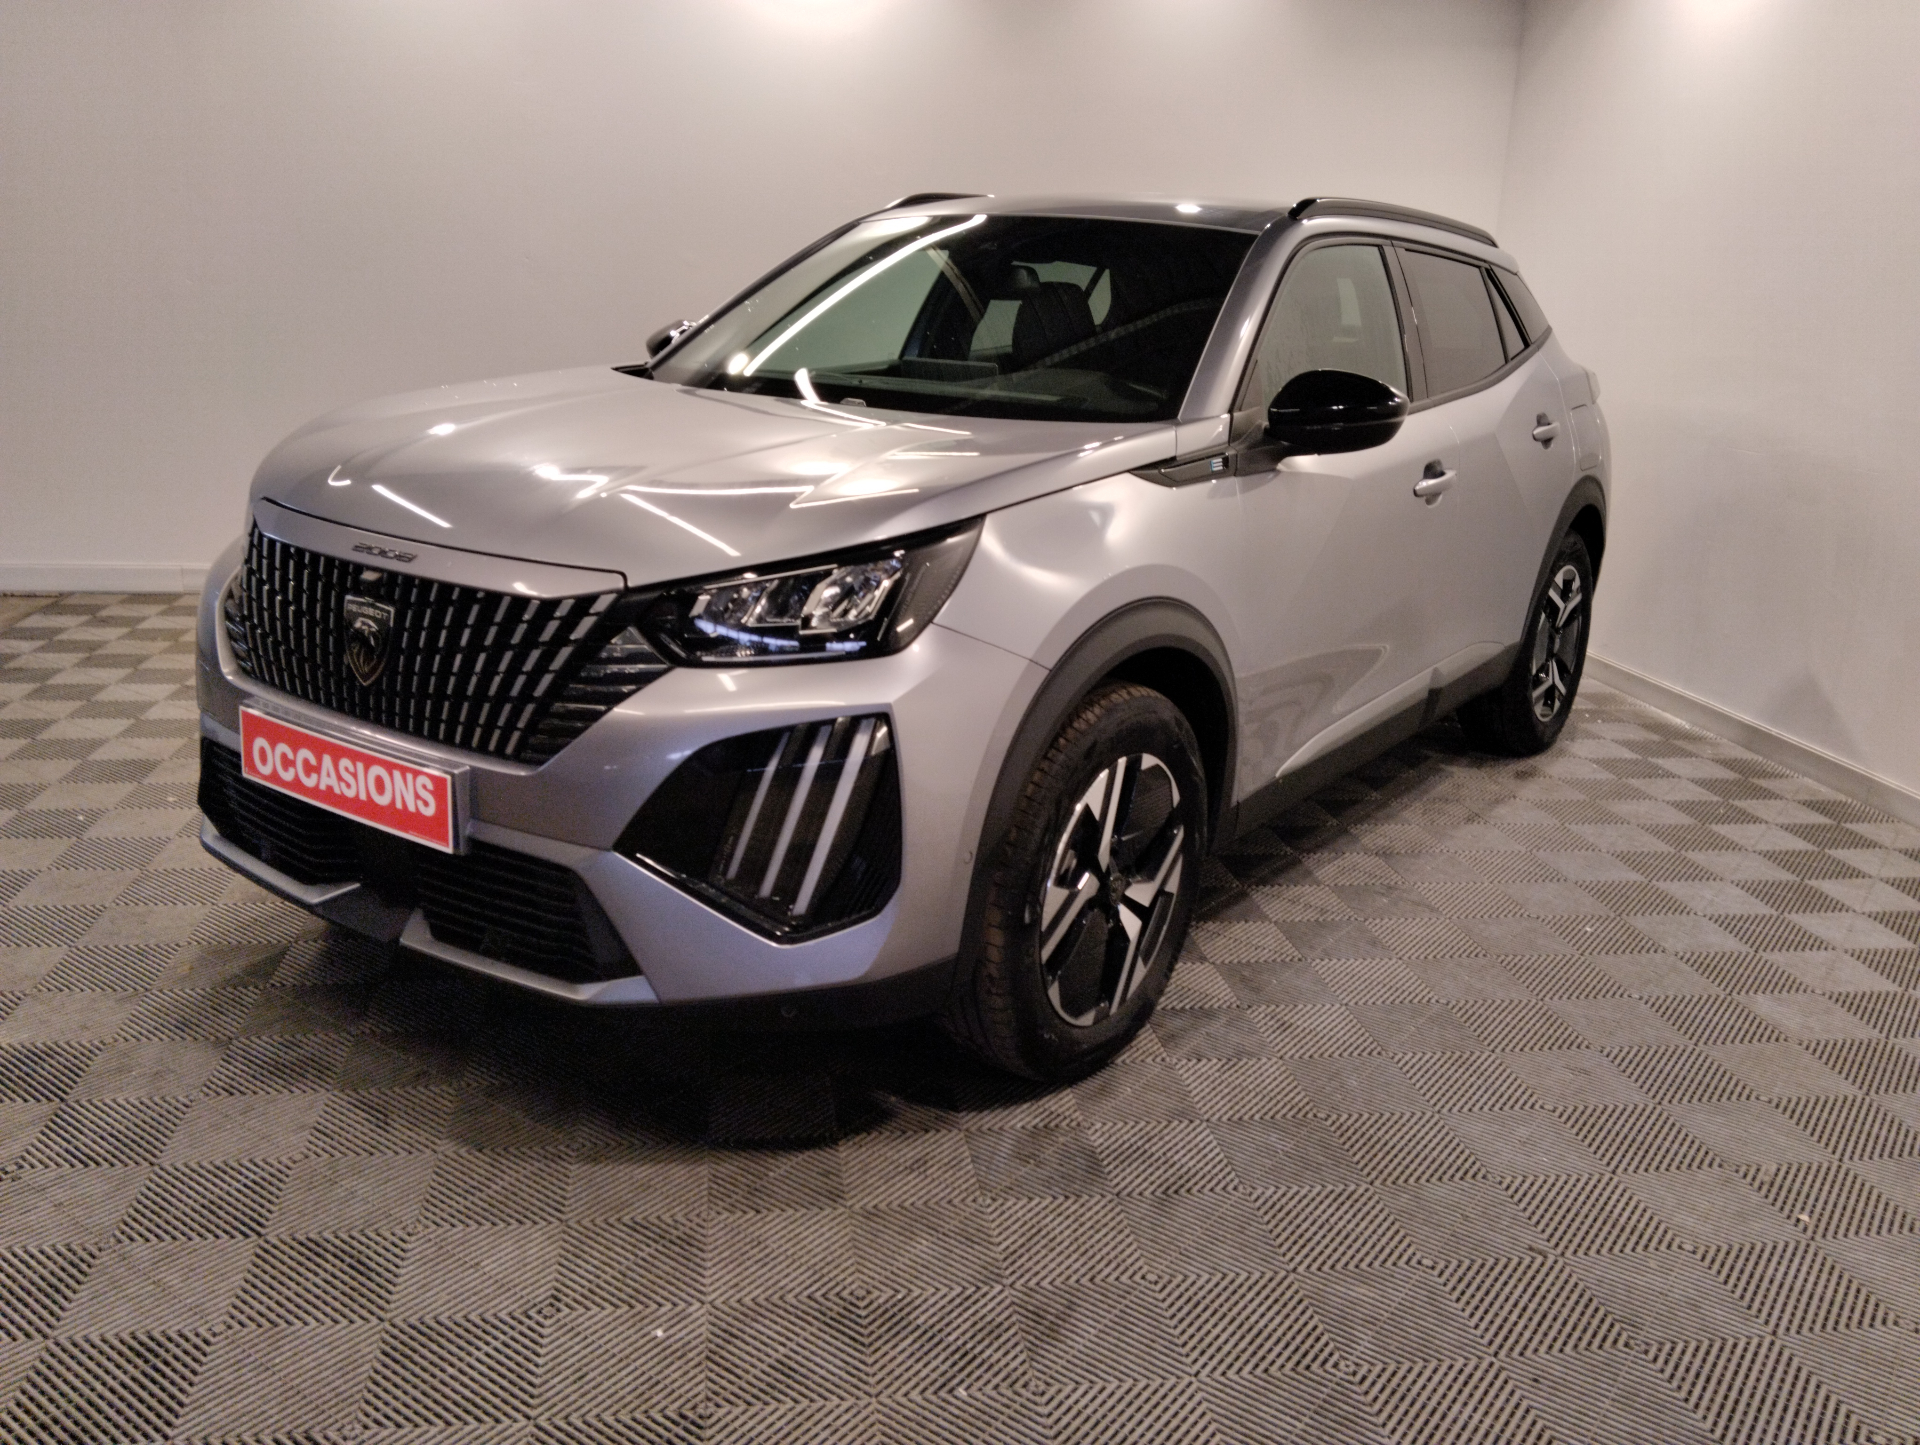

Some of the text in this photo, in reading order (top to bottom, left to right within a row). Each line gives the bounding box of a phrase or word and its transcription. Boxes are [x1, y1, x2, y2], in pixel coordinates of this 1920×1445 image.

[352, 542, 418, 563] 2008
[347, 603, 389, 620] PEUGEOT
[253, 737, 436, 817] OCCASIONS
